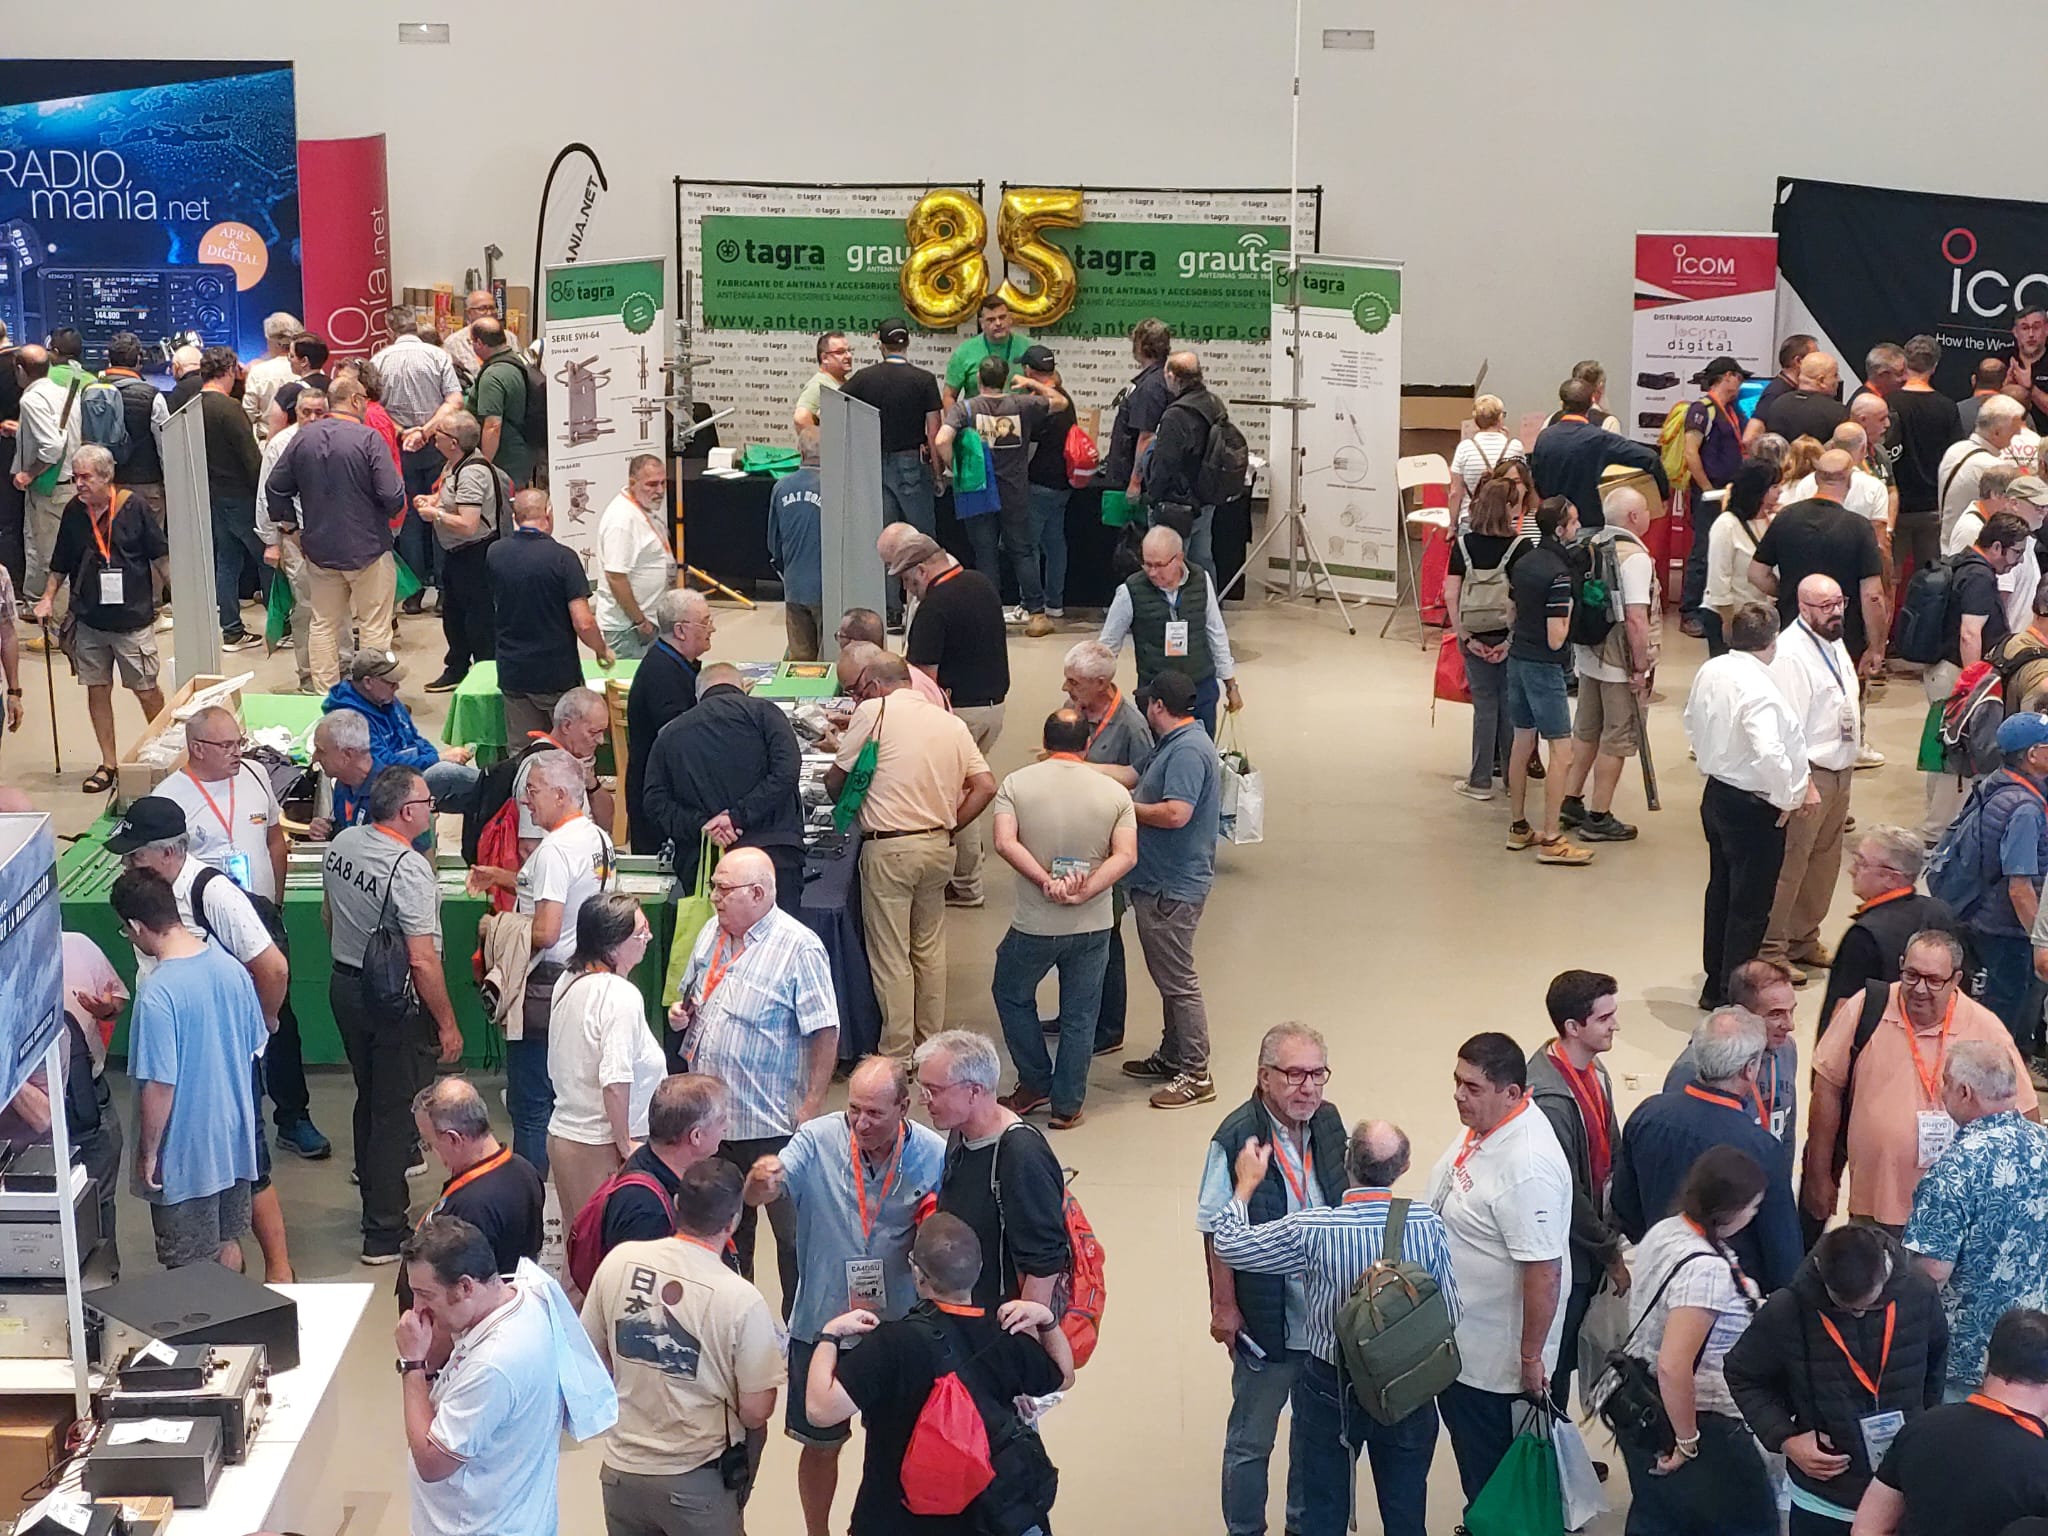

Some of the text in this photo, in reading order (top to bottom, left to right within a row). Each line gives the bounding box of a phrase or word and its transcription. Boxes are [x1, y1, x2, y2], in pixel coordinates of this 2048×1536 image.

[0, 150, 125, 188] RADIO
[221, 227, 252, 241] APRS
[229, 240, 239, 248] &
[207, 244, 258, 265] DIGITAL
[745, 239, 825, 270] tagra
[1074, 244, 1156, 276] tagra
[716, 279, 770, 287] FABRICANTE
[773, 280, 784, 288] DE
[786, 280, 827, 288] ANTENAS
[836, 282, 891, 290] ACCESORIOS
[1116, 287, 1158, 296] ANTENAS
[1168, 288, 1222, 297] ACCESORIOS
[1303, 276, 1345, 294] tagra
[577, 286, 615, 302] tagra
[1654, 314, 1703, 322] DISTRIBUIDOR
[552, 331, 600, 342] SERIE SVH-64
[1282, 328, 1310, 338] NUVA
[1668, 339, 1733, 353] digital
[1936, 333, 1964, 348] How
[1966, 336, 1984, 350] the
[326, 851, 376, 898] EA8 AA
[624, 1266, 657, 1314] 日本
